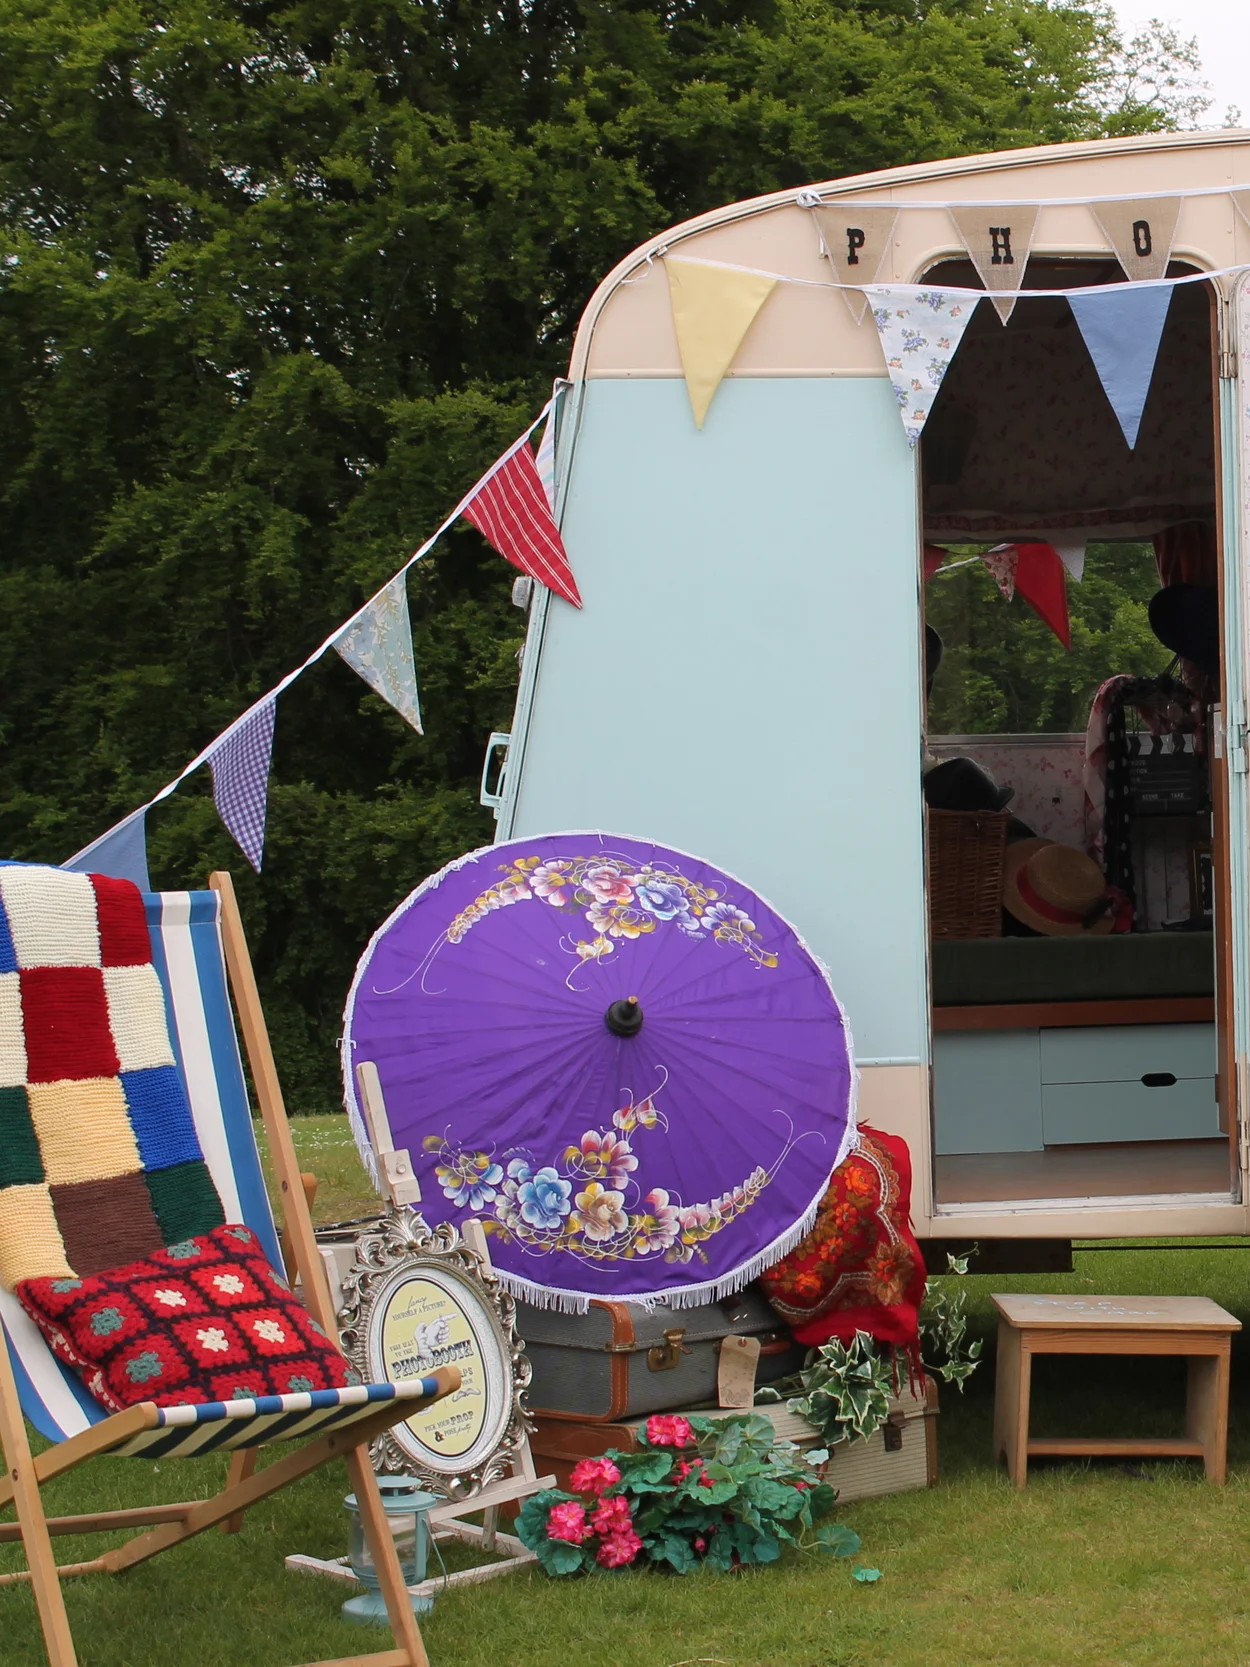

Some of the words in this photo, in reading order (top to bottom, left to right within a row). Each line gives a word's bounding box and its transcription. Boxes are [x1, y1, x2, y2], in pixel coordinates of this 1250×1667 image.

[392, 1307, 417, 1321] YOURSELF
[424, 1424, 436, 1432] PICK
[437, 1419, 450, 1428] YOUR
[450, 1410, 474, 1426] PROP
[434, 1430, 445, 1442] &
[444, 1427, 457, 1436] POSE
